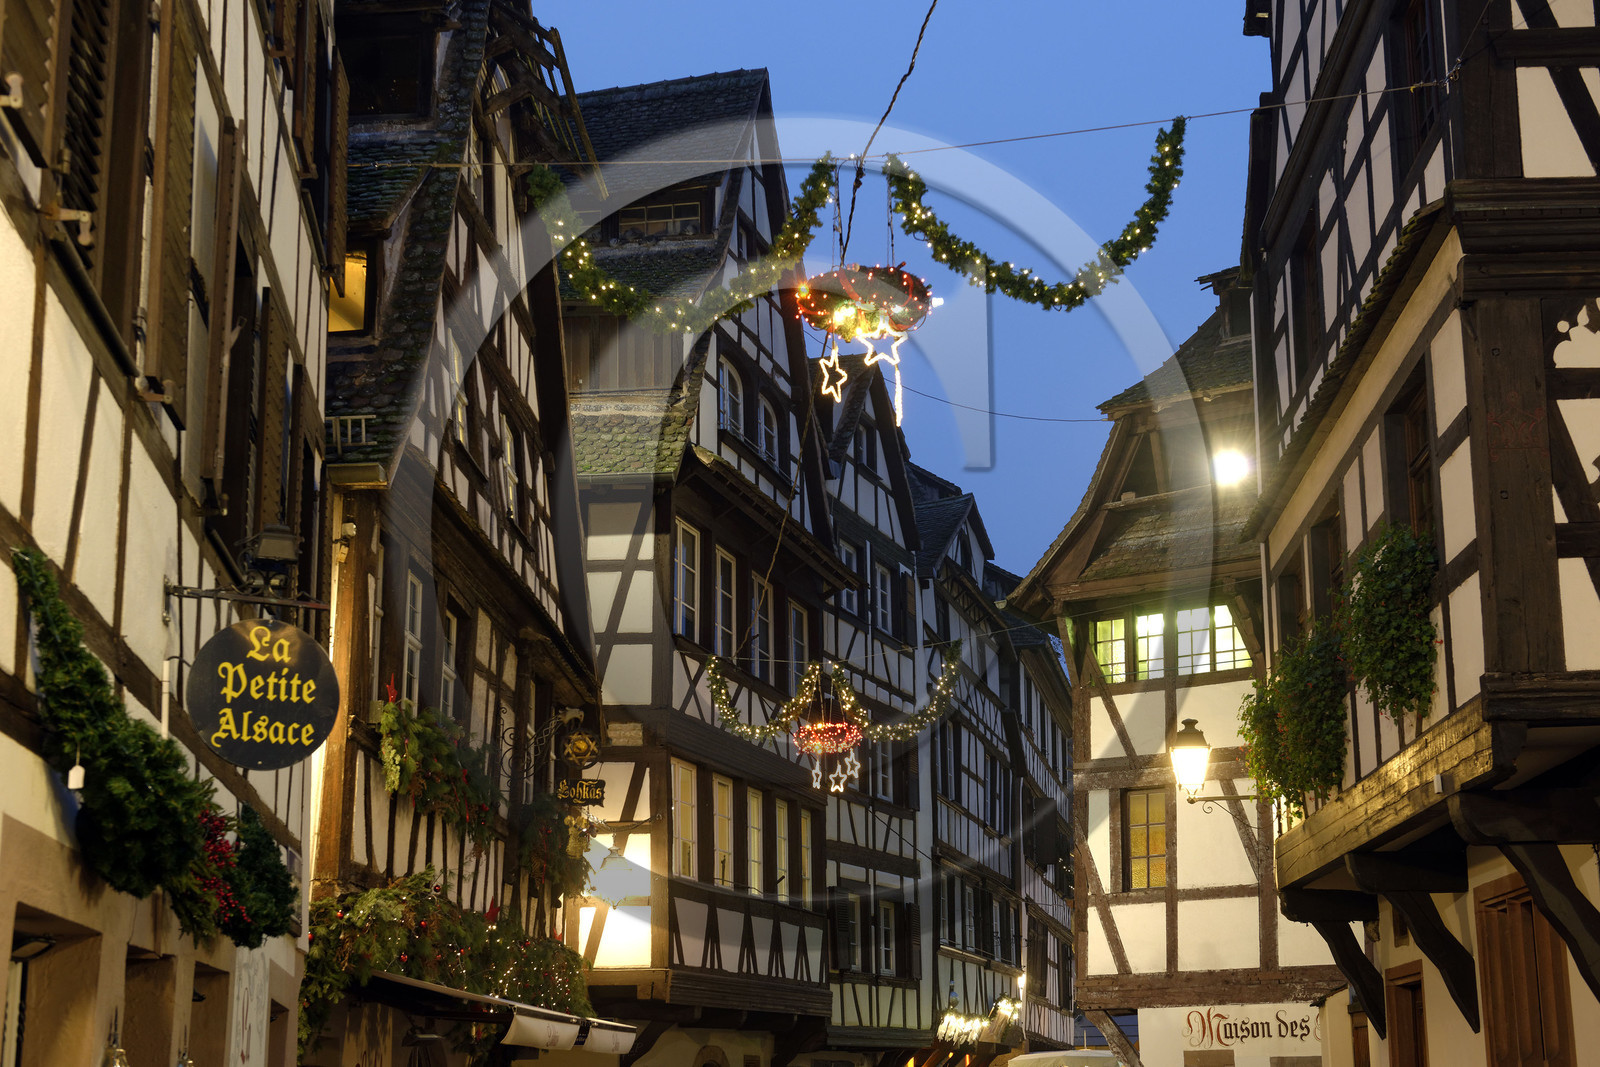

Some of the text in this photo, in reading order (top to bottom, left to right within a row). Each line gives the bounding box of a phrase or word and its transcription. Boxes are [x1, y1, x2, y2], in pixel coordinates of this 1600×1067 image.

[246, 625, 292, 663] La
[217, 661, 317, 704] Petite
[211, 708, 315, 748] Alsace
[557, 779, 603, 804] Lohkäs
[1181, 1007, 1273, 1049] Maison
[1275, 1009, 1310, 1043] des
